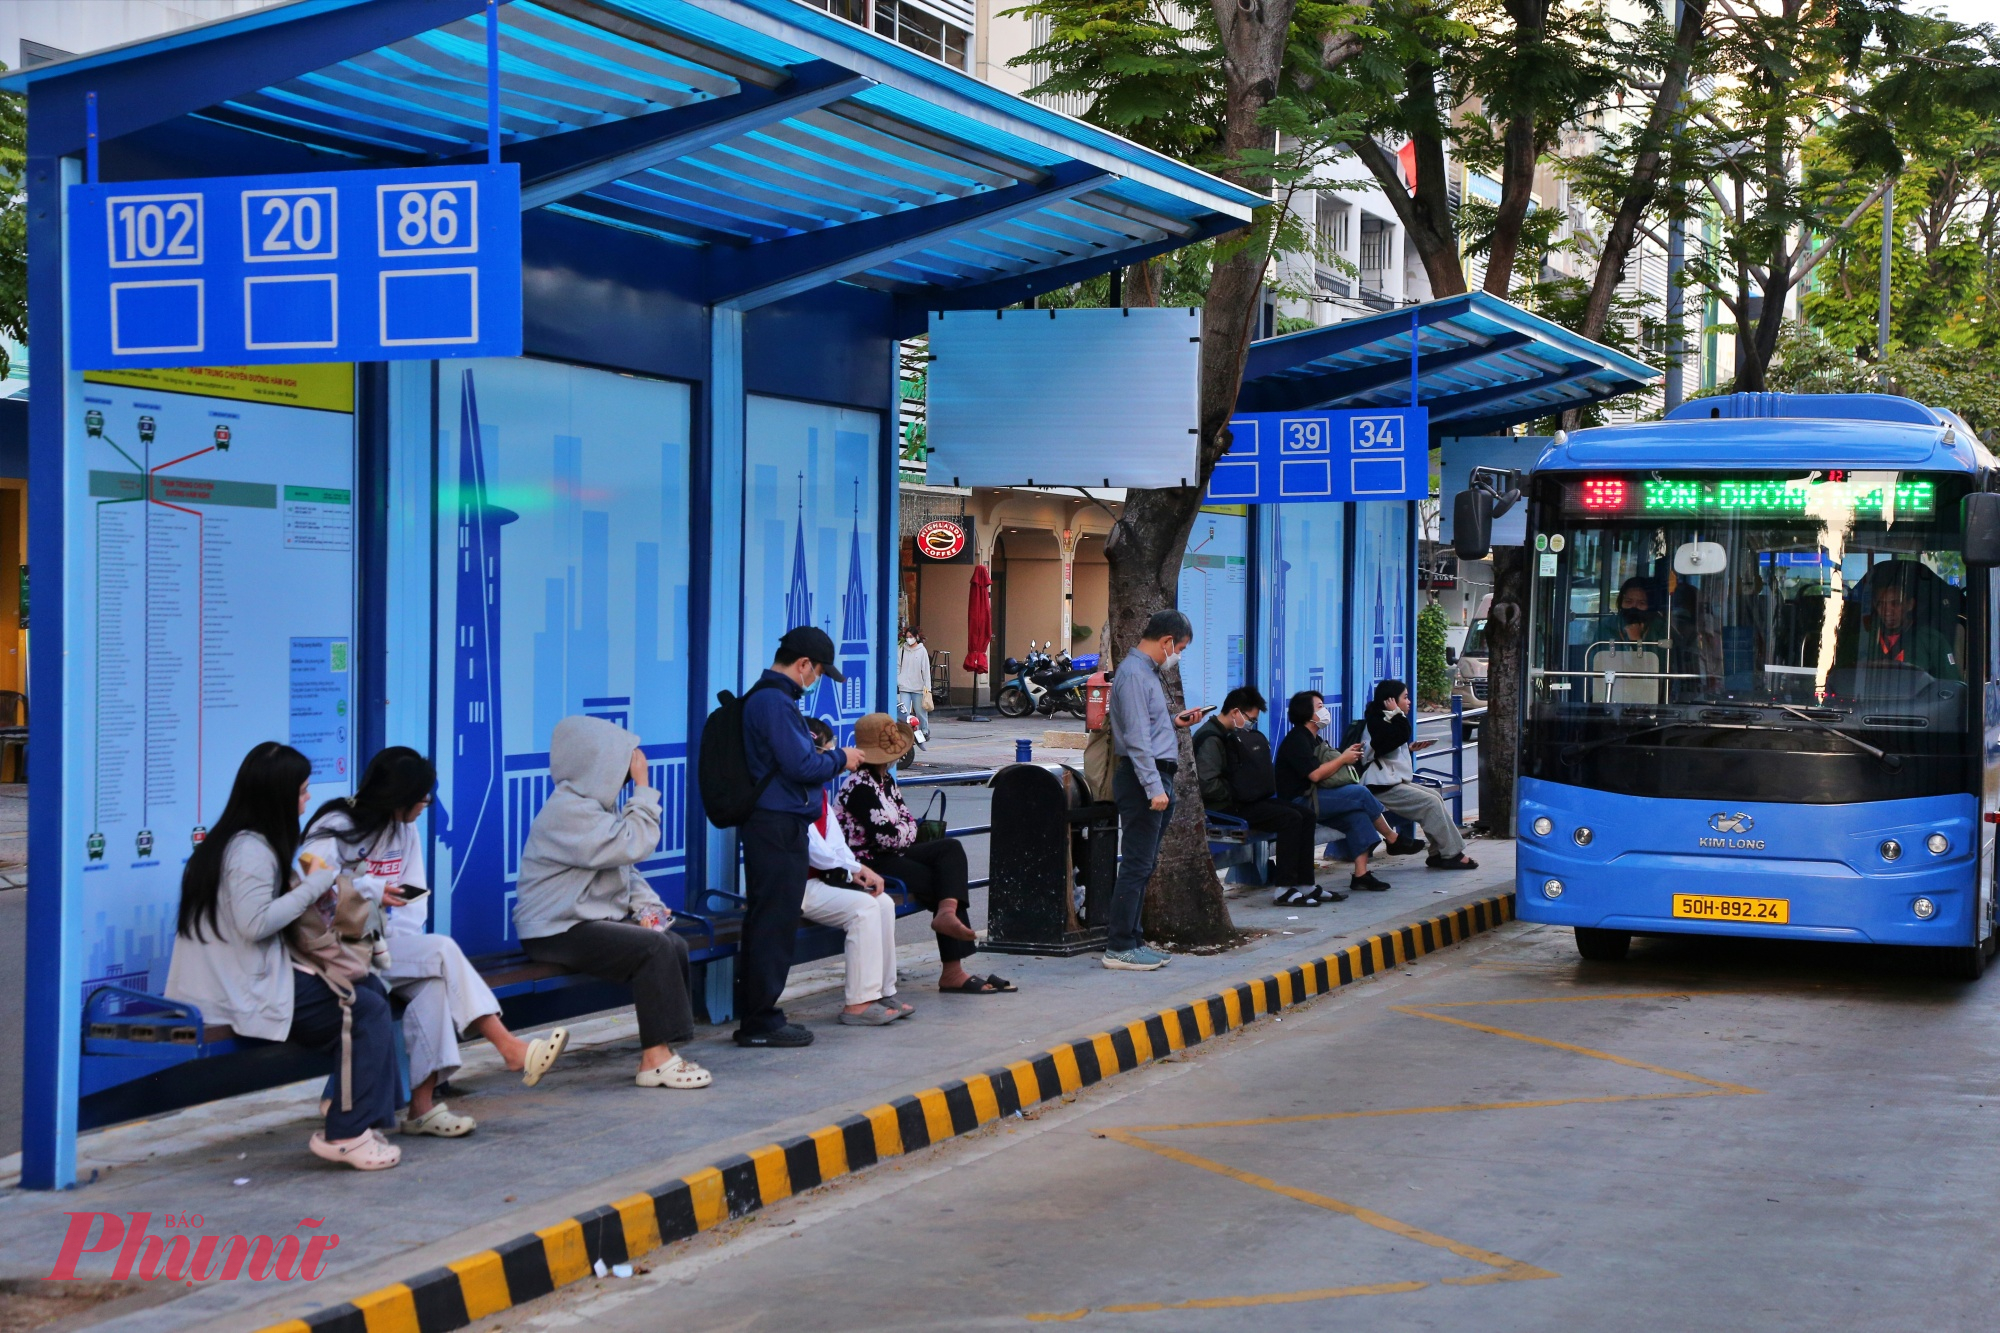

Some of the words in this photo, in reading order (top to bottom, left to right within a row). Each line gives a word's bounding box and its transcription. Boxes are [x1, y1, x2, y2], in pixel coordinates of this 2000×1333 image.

[262, 197, 322, 251] 20
[397, 190, 458, 246] 86
[119, 203, 195, 259] 102
[204, 368, 224, 378] TRUNG
[1289, 423, 1320, 449] 39
[1359, 420, 1394, 448] 34
[920, 522, 962, 539] HIGHLANDS
[925, 547, 957, 557] COFFEE
[1699, 837, 1725, 848] KIM
[1728, 839, 1765, 850] LONG
[1682, 898, 1778, 919] 50H-892.24
